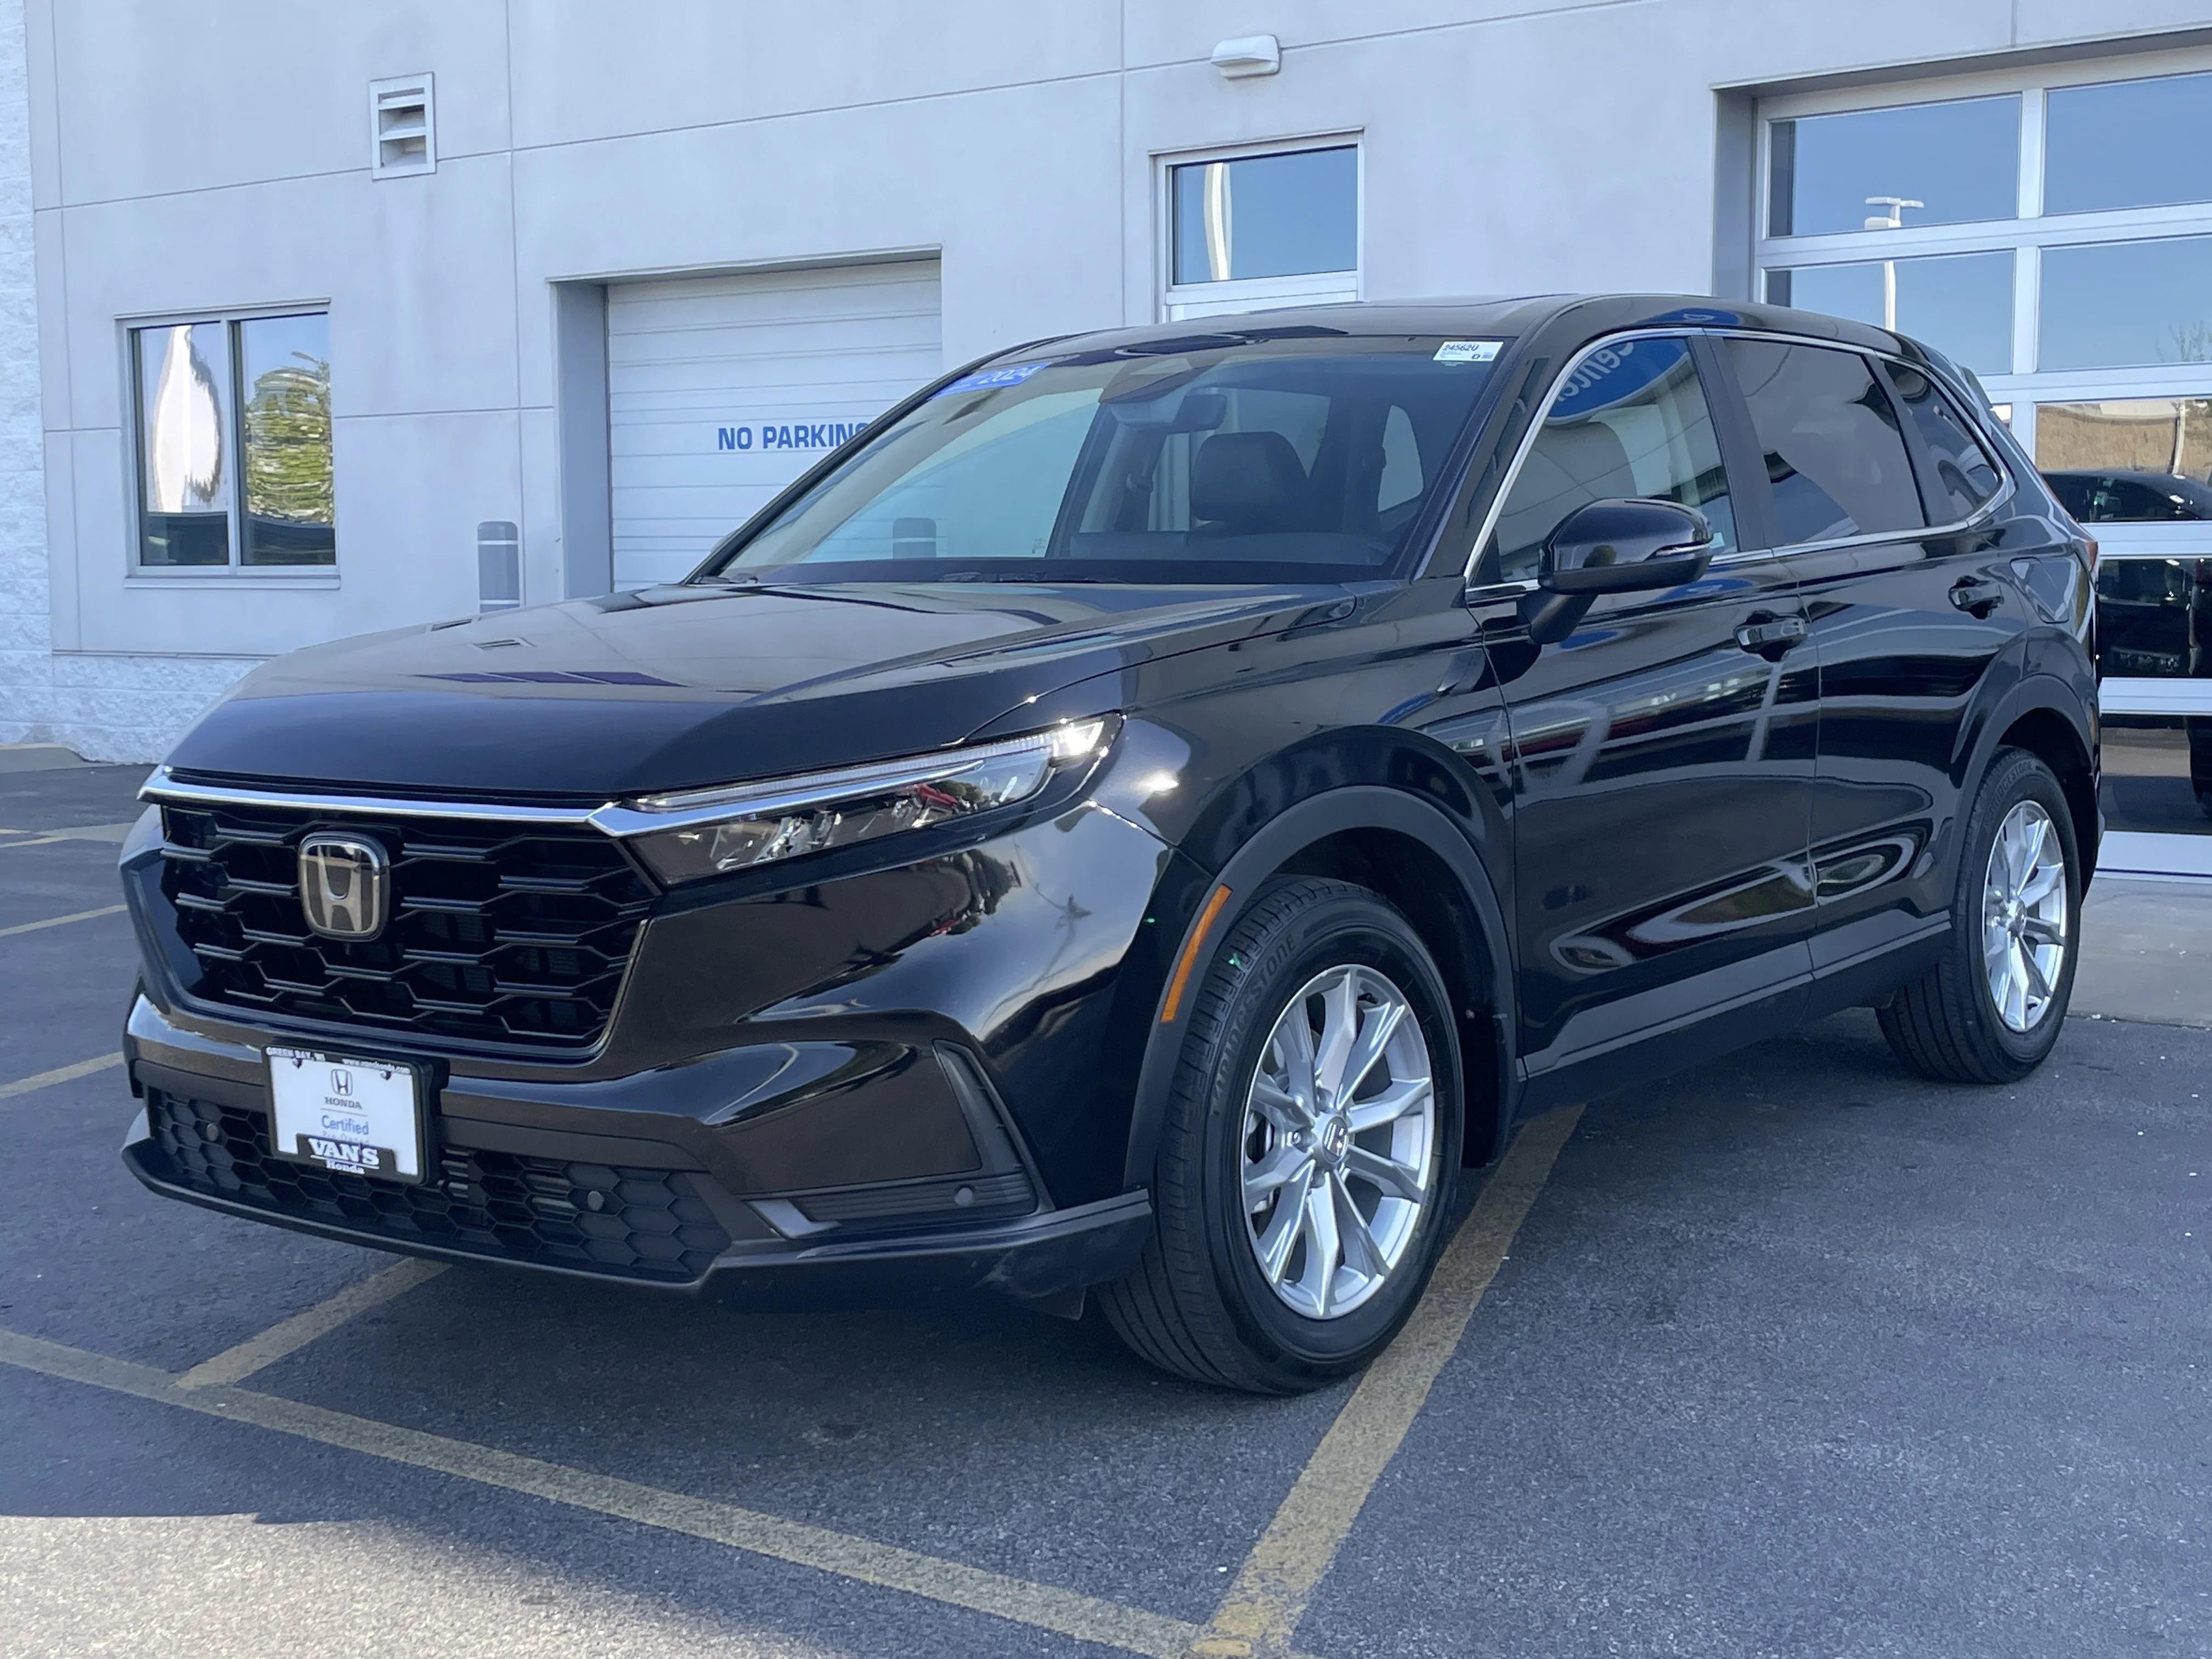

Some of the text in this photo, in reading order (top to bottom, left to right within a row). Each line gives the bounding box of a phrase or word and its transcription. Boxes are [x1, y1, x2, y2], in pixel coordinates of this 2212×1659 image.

[718, 427, 753, 450] NO
[324, 1097, 363, 1110] HONDA
[321, 1115, 369, 1135] Certified
[325, 1160, 365, 1175] Honda
